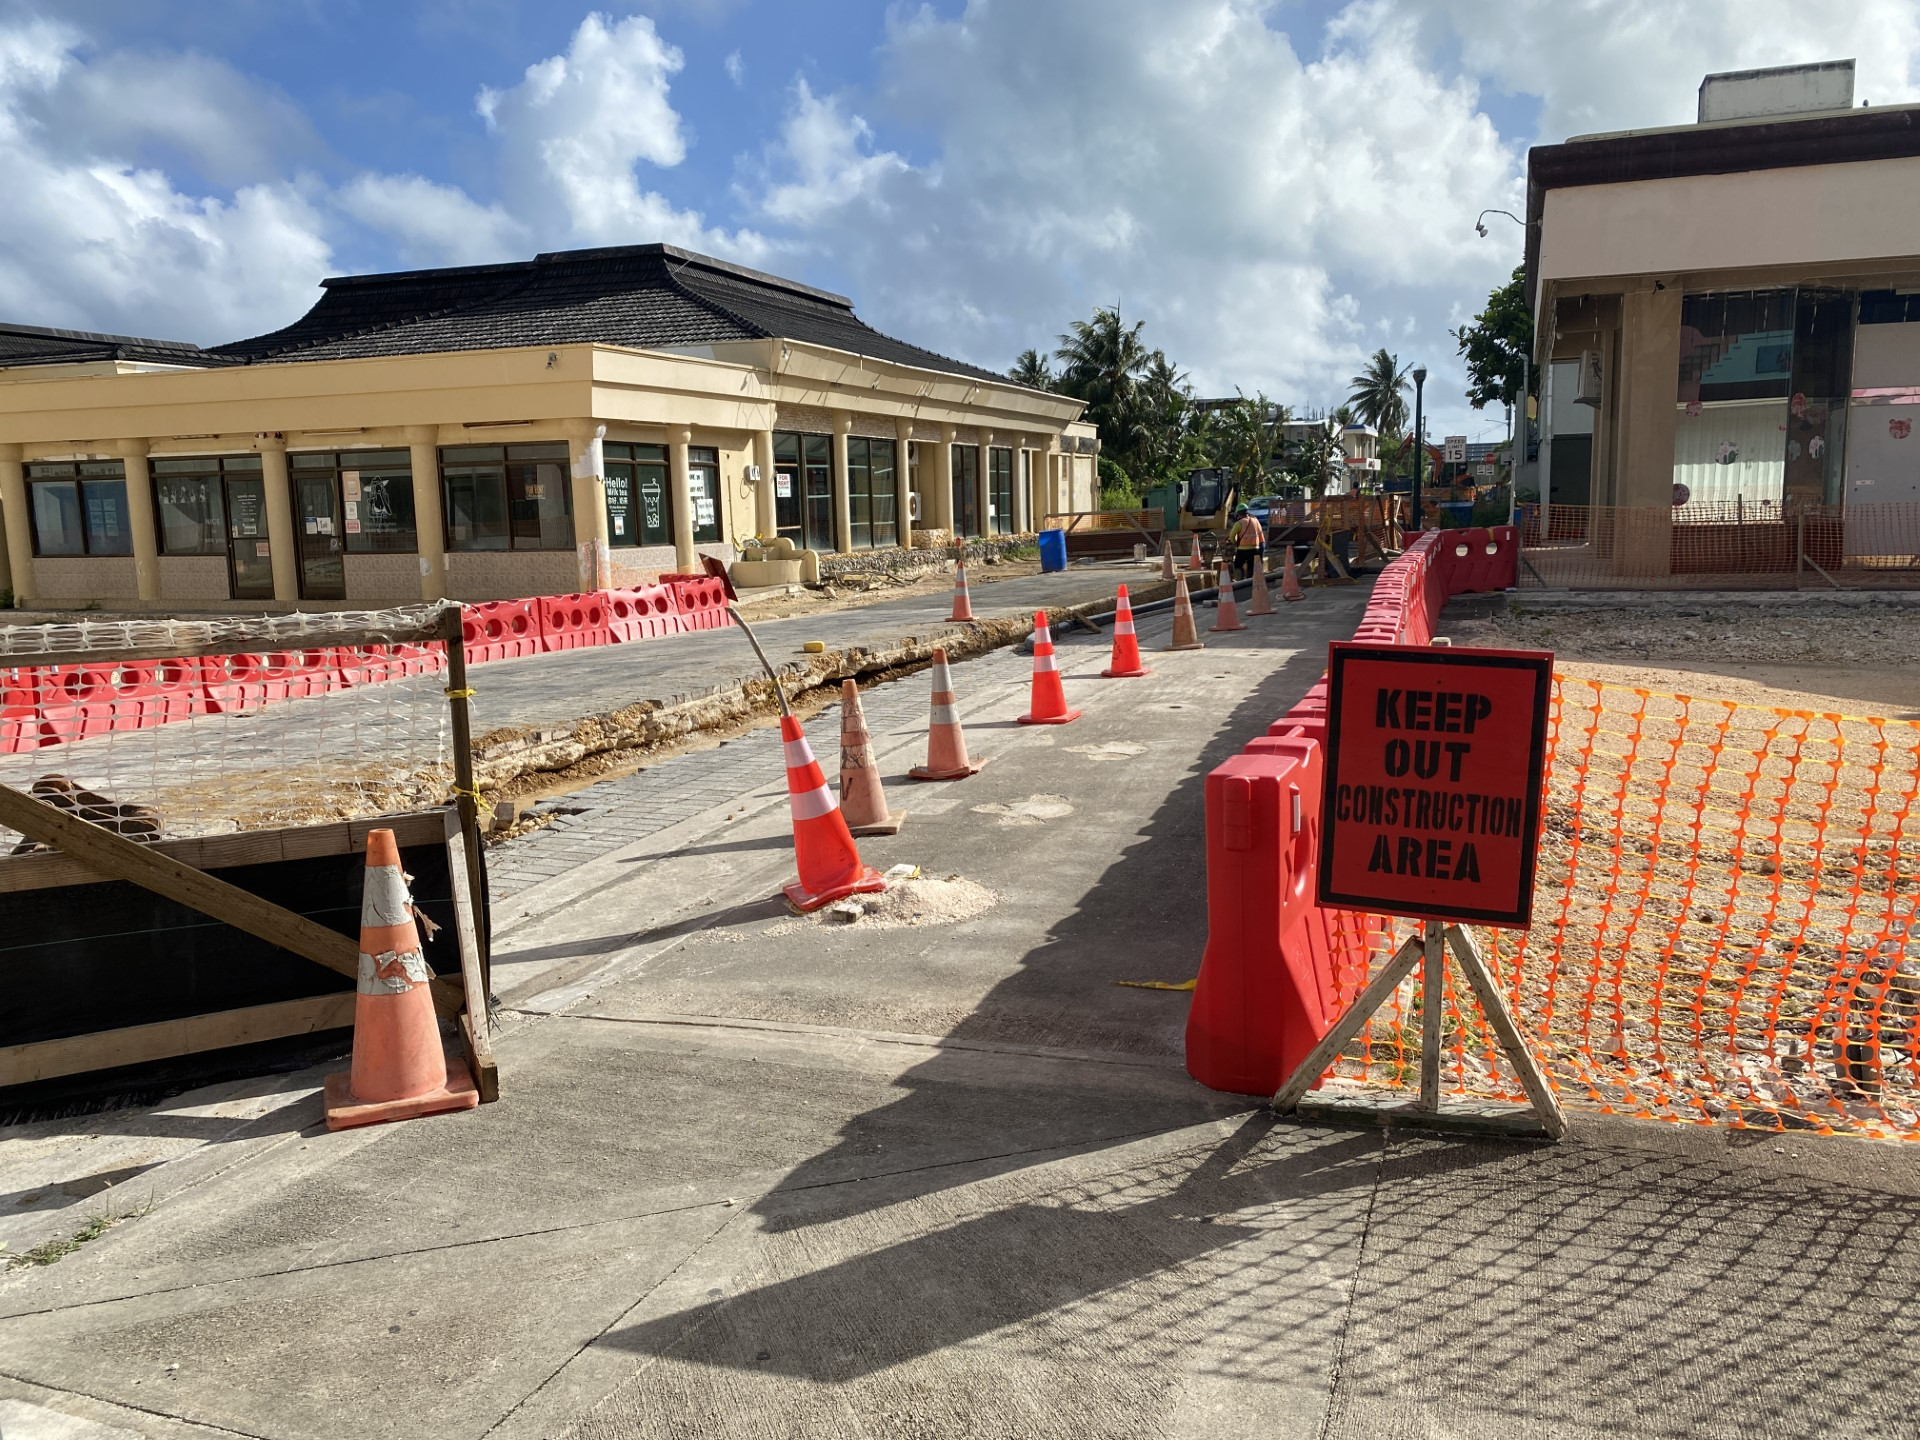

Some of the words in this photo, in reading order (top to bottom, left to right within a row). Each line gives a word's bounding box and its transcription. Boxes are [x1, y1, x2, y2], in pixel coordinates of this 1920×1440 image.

[1448, 450, 1463, 460] 15
[605, 477, 628, 488] Hello!
[607, 488, 618, 496] Milk
[619, 488, 628, 496] tea
[1375, 687, 1493, 734] KEEP
[1384, 738, 1471, 782] OUT
[1336, 783, 1522, 838] CONSTRUCTION
[1367, 834, 1481, 883] AREA
